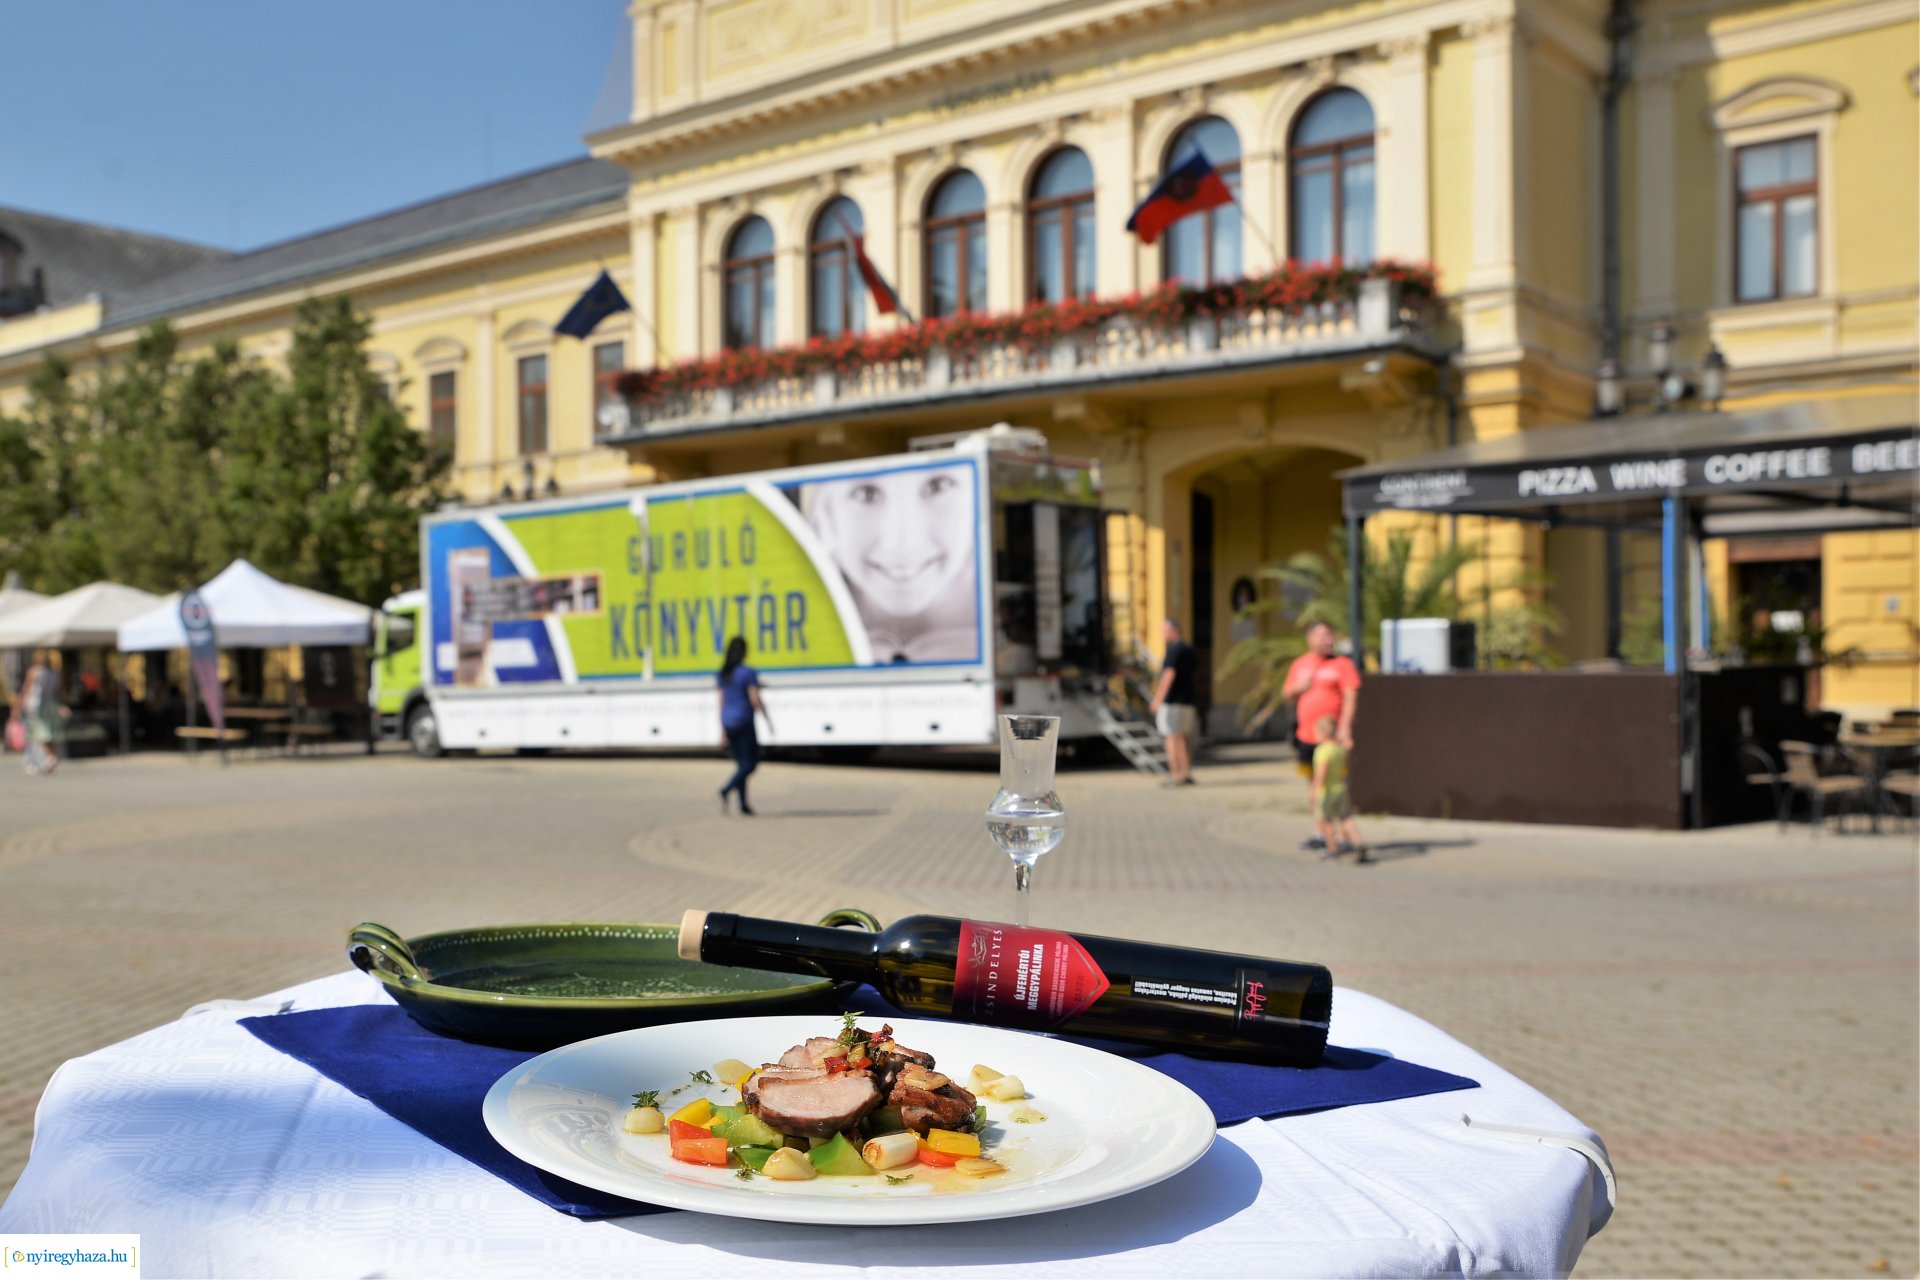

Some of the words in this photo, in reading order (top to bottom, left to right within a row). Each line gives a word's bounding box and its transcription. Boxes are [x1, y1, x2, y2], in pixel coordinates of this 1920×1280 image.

[1518, 466, 1597, 497] PIZZA
[1610, 459, 1687, 490] WINE
[1704, 447, 1831, 484] COFFEE
[985, 929, 1003, 1016] ZSINDELYES
[1013, 949, 1030, 1001] ÚJFEHÉRTÓI
[1027, 944, 1044, 1011] MEGGYPÁLINKA
